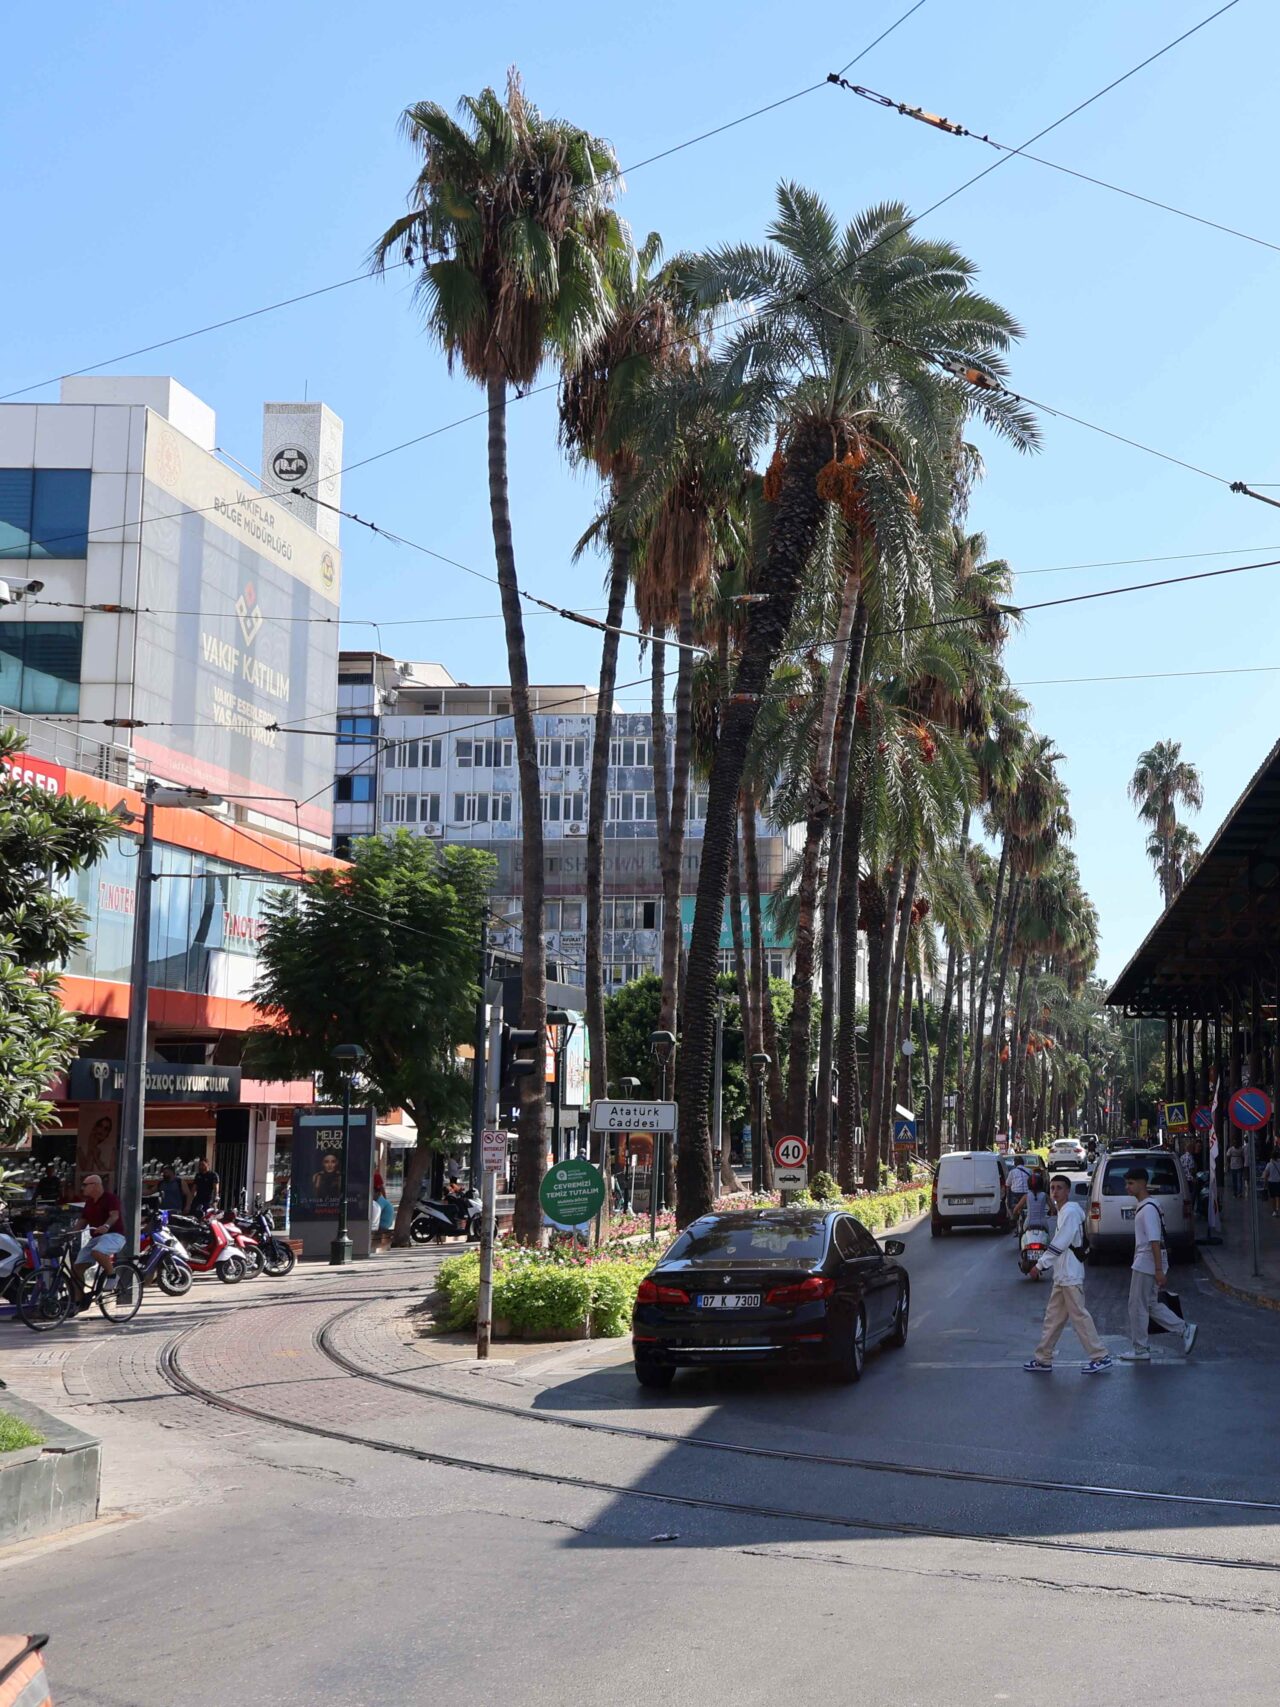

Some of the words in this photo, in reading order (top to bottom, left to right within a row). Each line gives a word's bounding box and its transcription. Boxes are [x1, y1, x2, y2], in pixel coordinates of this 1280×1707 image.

[202, 632, 239, 674] VAKIF
[242, 654, 290, 702] KATILIM
[176, 1075, 229, 1092] KUYUMCULUK
[611, 1106, 659, 1116] Atatürk
[609, 1118, 659, 1128] Caddesi
[781, 1145, 800, 1159] 40
[569, 1188, 599, 1197] TUTALIM
[703, 1296, 715, 1306] 07
[735, 1295, 759, 1306] 7300
